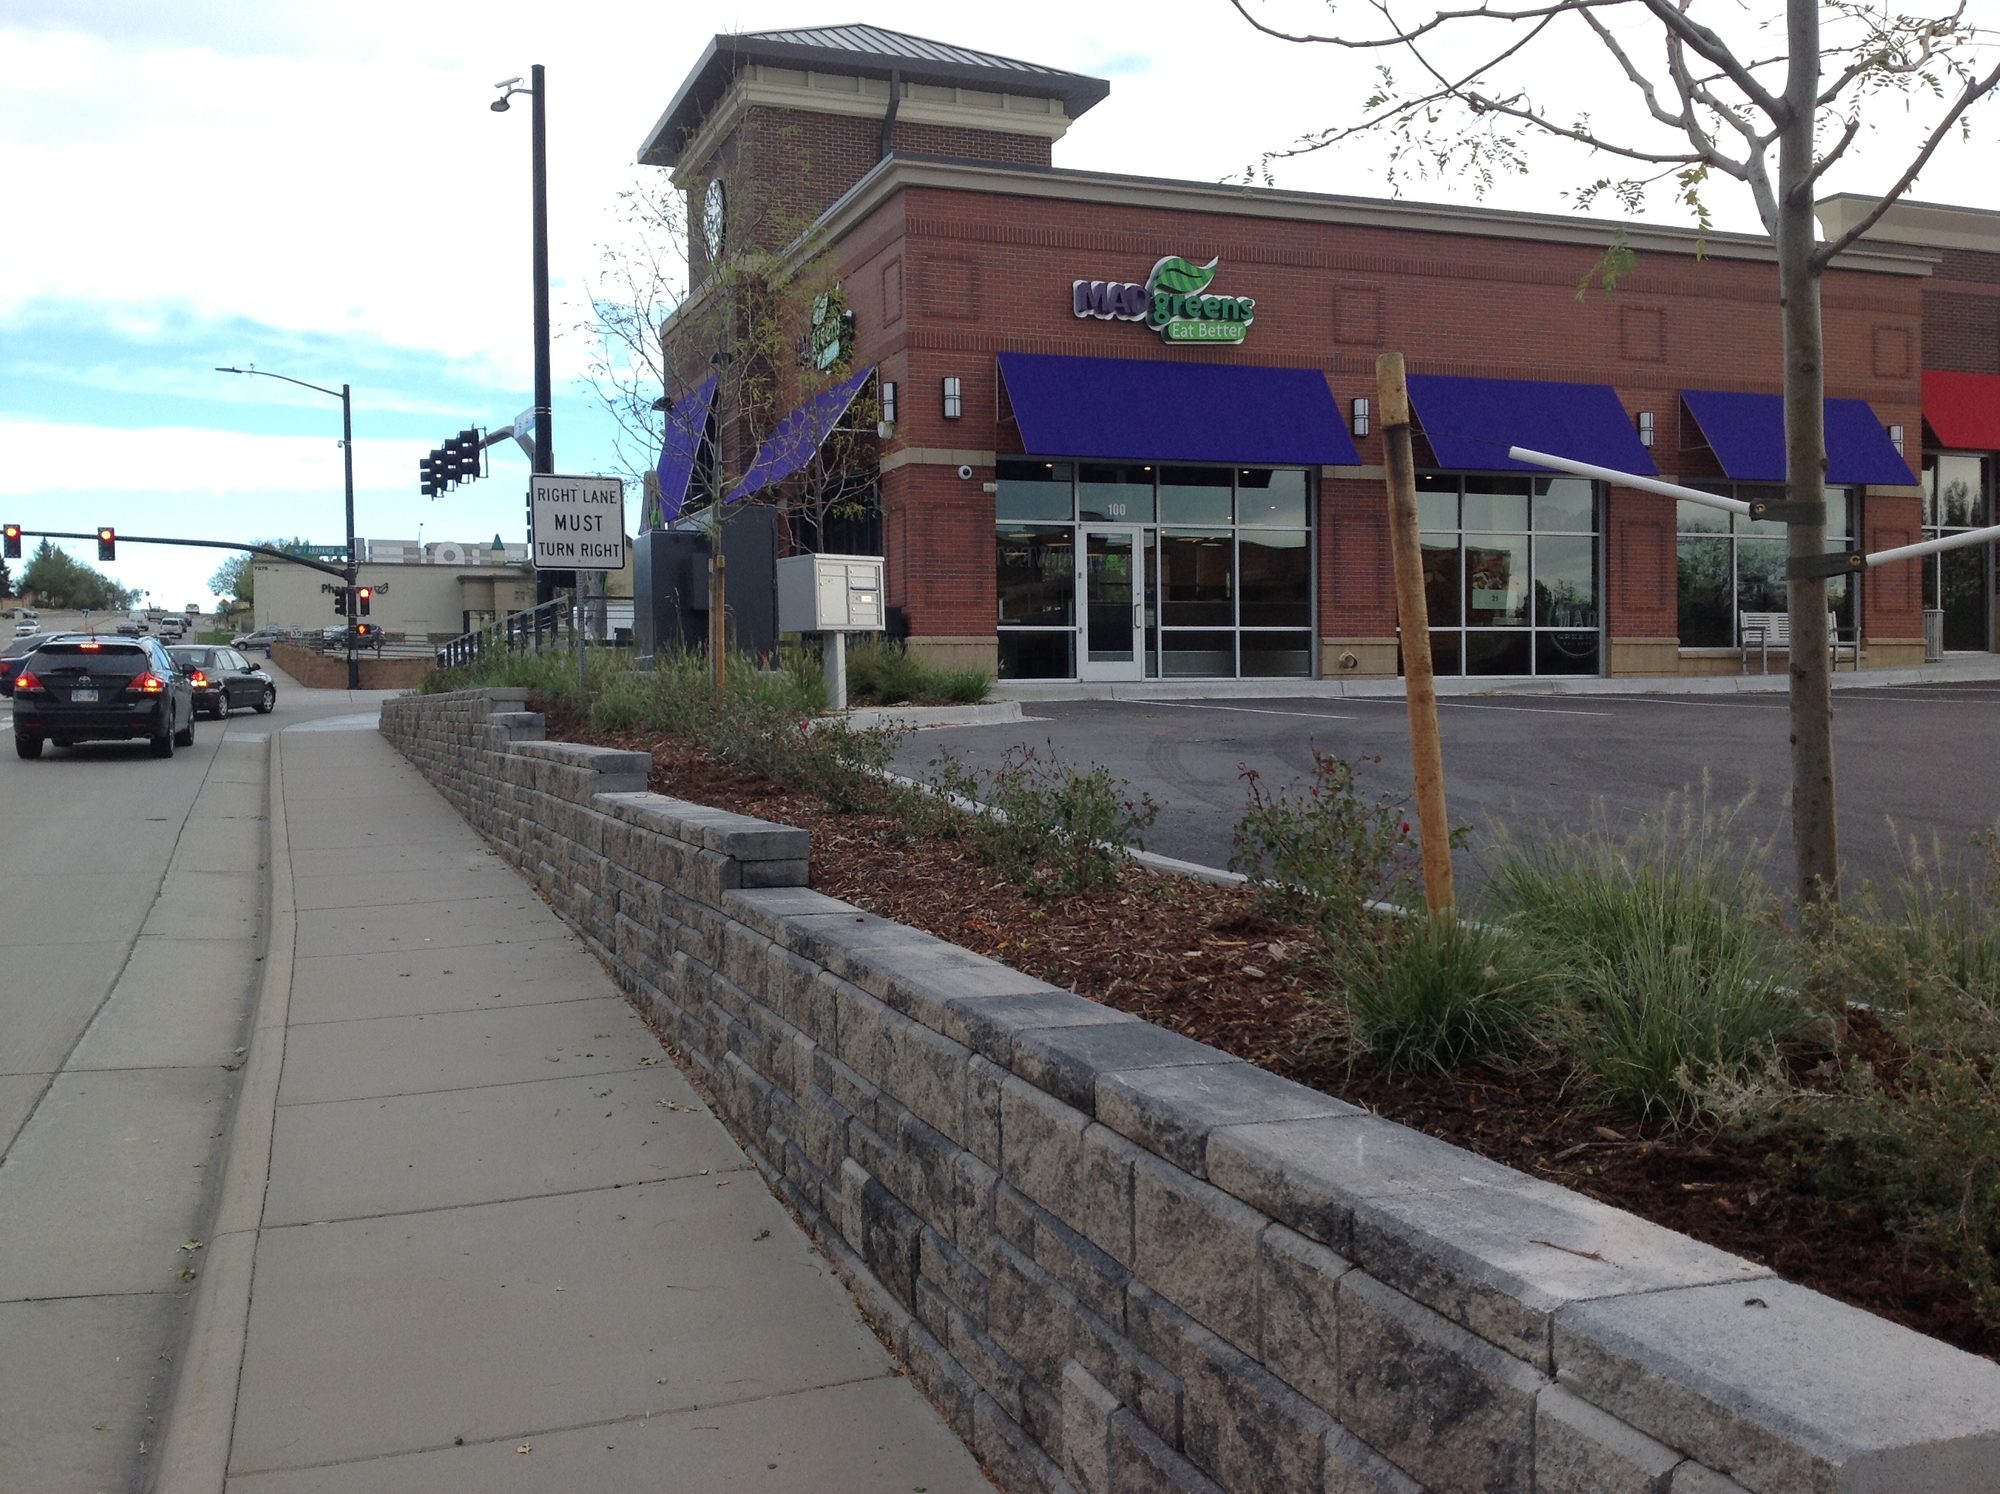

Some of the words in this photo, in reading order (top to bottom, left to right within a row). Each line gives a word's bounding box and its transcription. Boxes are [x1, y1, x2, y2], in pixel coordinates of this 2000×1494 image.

[1075, 281, 1150, 318] MAD
[1153, 293, 1254, 325] greens
[1171, 323, 1194, 337] Eat
[1199, 323, 1244, 338] Better
[537, 487, 577, 502] RIGHT
[583, 489, 617, 504] LANE
[1108, 503, 1126, 516] 100
[555, 514, 603, 532] MUST
[538, 542, 575, 557] TURN
[581, 543, 620, 557] RIGHT
